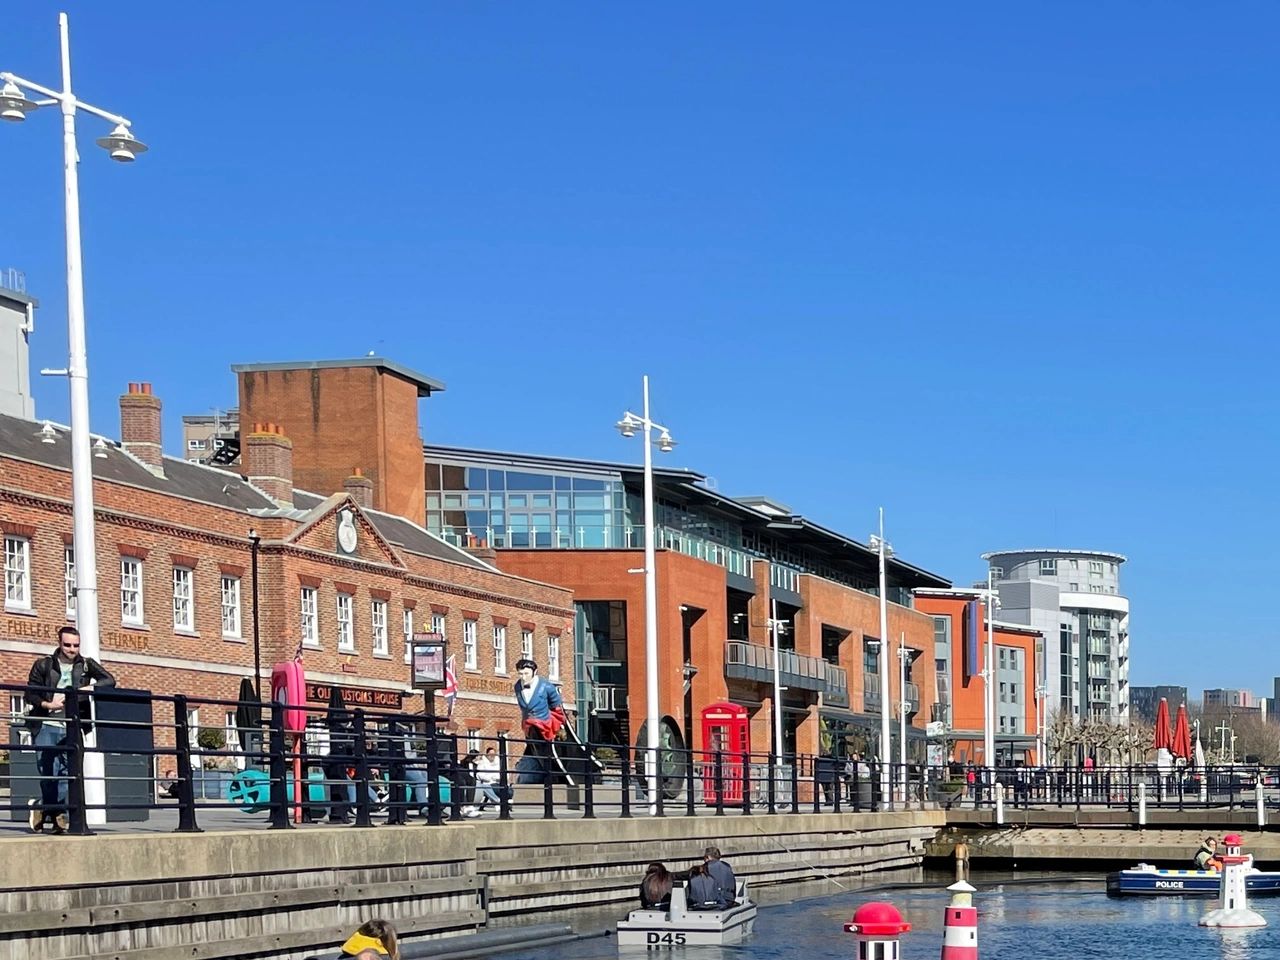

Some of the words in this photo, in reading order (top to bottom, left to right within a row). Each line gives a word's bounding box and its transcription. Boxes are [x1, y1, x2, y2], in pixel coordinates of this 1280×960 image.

[8, 619, 51, 639] FULLER
[107, 632, 150, 650] TURNER
[341, 689, 373, 704] USTOMS
[374, 692, 399, 706] HOUSE
[1155, 881, 1184, 889] POLICE
[647, 932, 687, 945] D45
